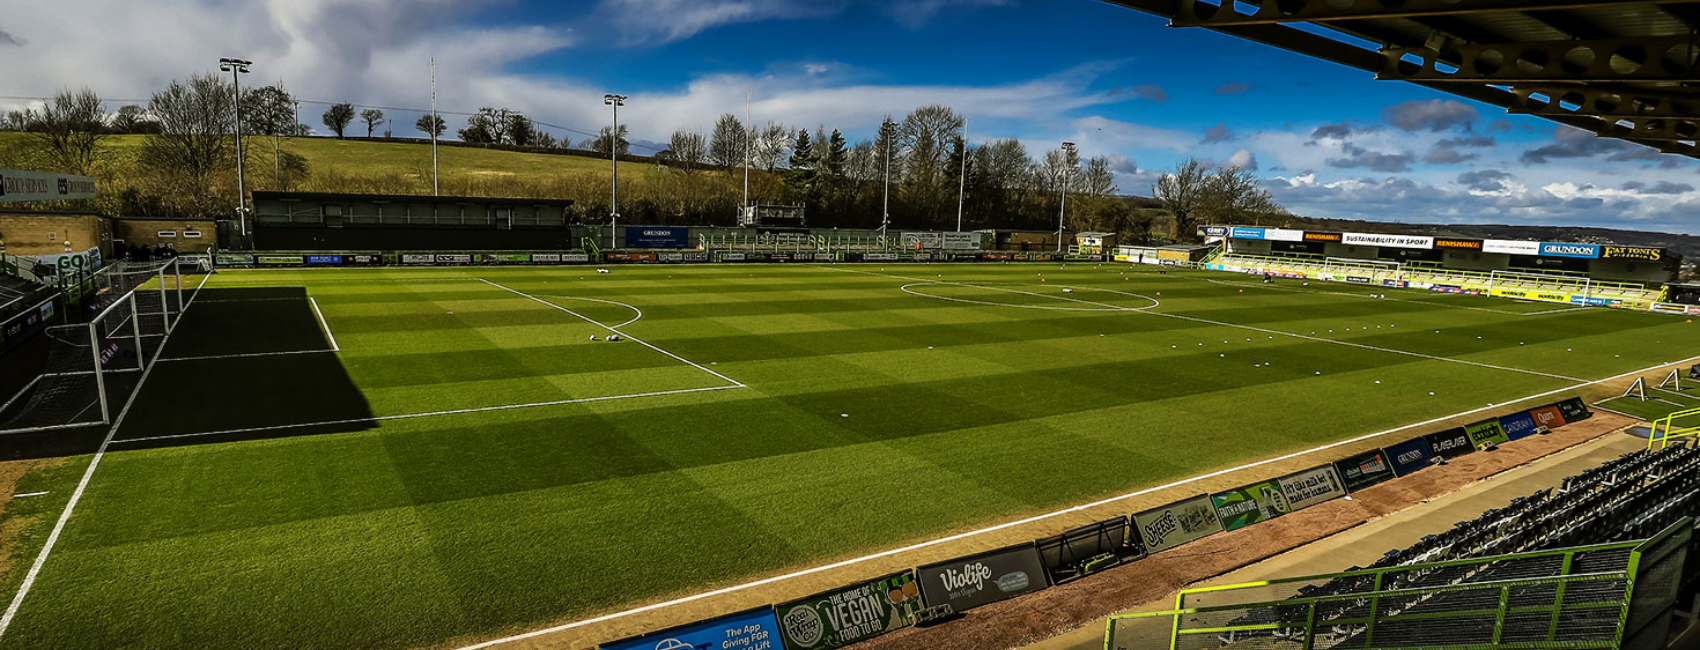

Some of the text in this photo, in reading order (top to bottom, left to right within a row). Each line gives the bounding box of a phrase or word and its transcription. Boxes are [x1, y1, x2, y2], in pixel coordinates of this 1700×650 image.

[1346, 235, 1395, 244] SUSTAINABILITY
[1436, 240, 1472, 248] RENISHAW
[1544, 244, 1594, 256] GRUNDON
[1602, 246, 1626, 258] FAT
[1218, 505, 1234, 518] FAITH
[1238, 499, 1257, 514] NATURE
[1145, 510, 1176, 544] SHEESE
[940, 562, 991, 591] Violife
[829, 585, 871, 605] THE HOME OF
[786, 609, 808, 627] Real
[825, 593, 885, 631] VEGAN
[725, 624, 761, 639] The App
[790, 618, 818, 638] Wrap
[804, 630, 817, 642] Co.
[839, 618, 882, 641] FOOD TO GO
[722, 637, 750, 650] Giving
[751, 630, 768, 642] FGR
[755, 640, 771, 650] Lift
